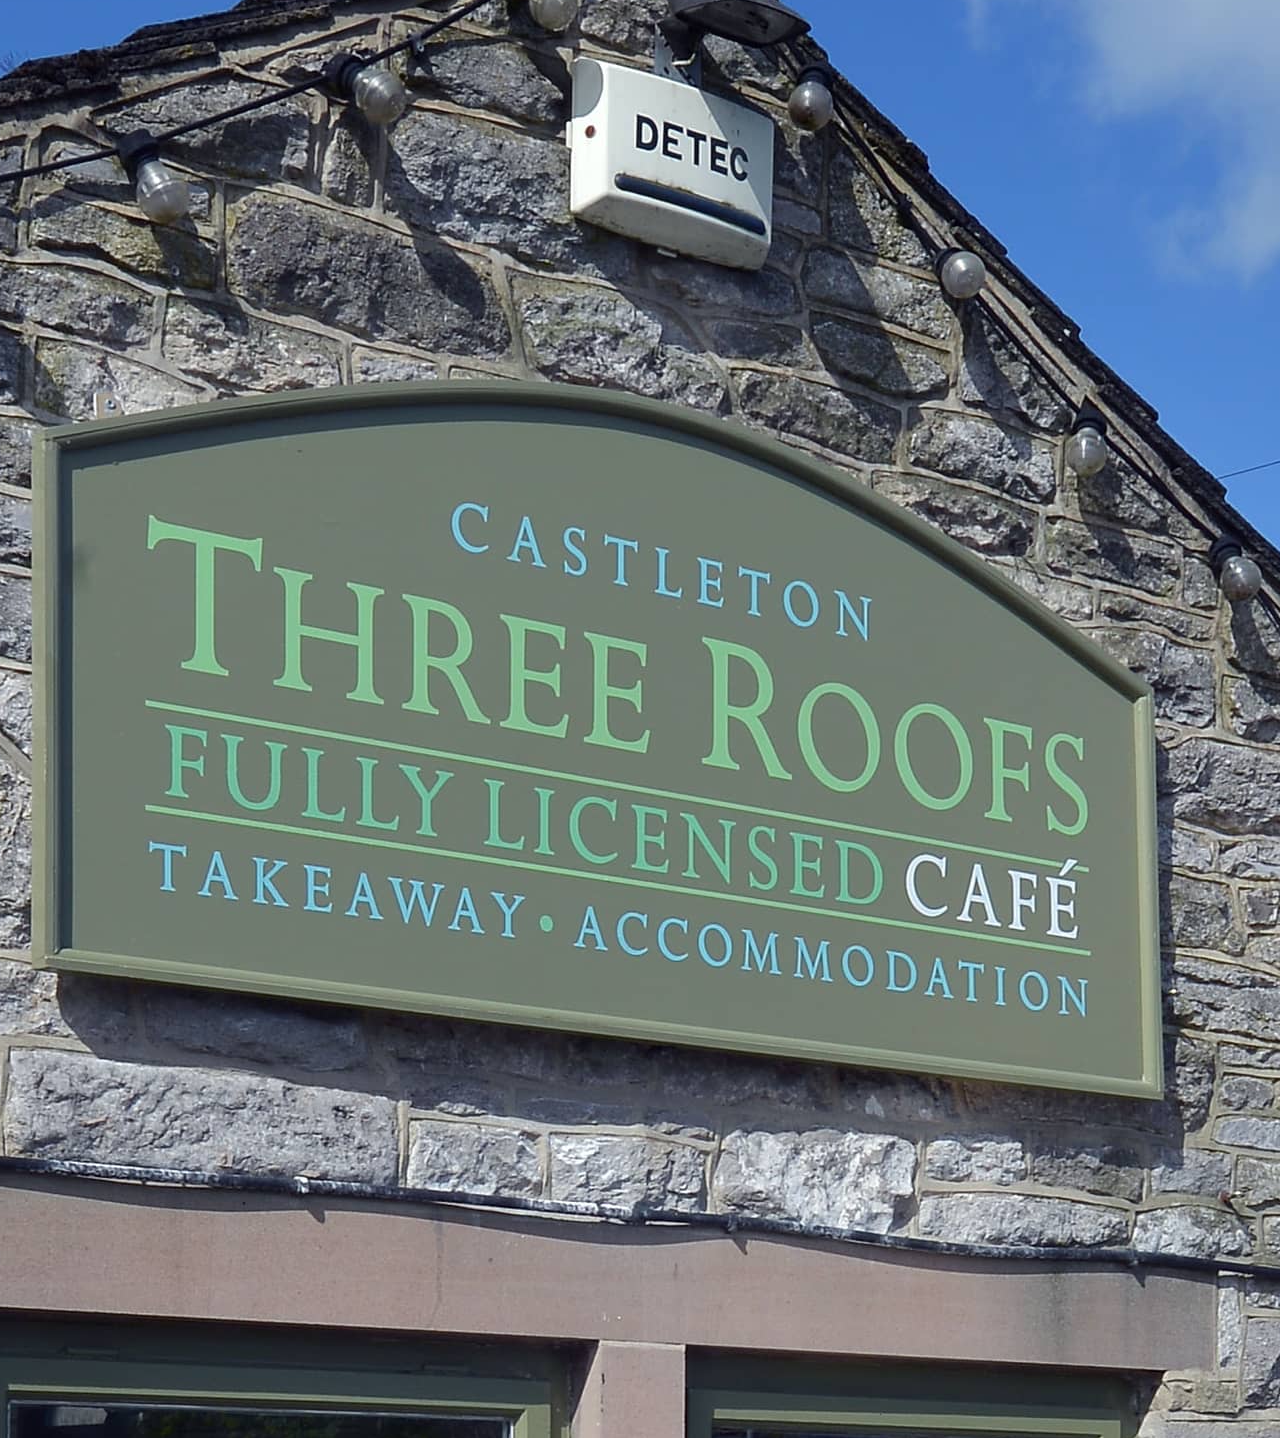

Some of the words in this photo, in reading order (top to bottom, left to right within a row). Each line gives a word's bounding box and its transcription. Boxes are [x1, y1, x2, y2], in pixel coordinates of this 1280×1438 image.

[634, 113, 749, 182] DETEC
[450, 501, 874, 642] CASTLETON
[146, 513, 652, 755] THREE
[700, 635, 1089, 837] ROOFS
[163, 723, 455, 838] FULLY
[482, 777, 884, 905] LICENSED
[904, 852, 1080, 940] CAFÉ
[147, 839, 527, 939] TAKEAWAY
[572, 904, 1090, 1018] ACCOMMODATION
